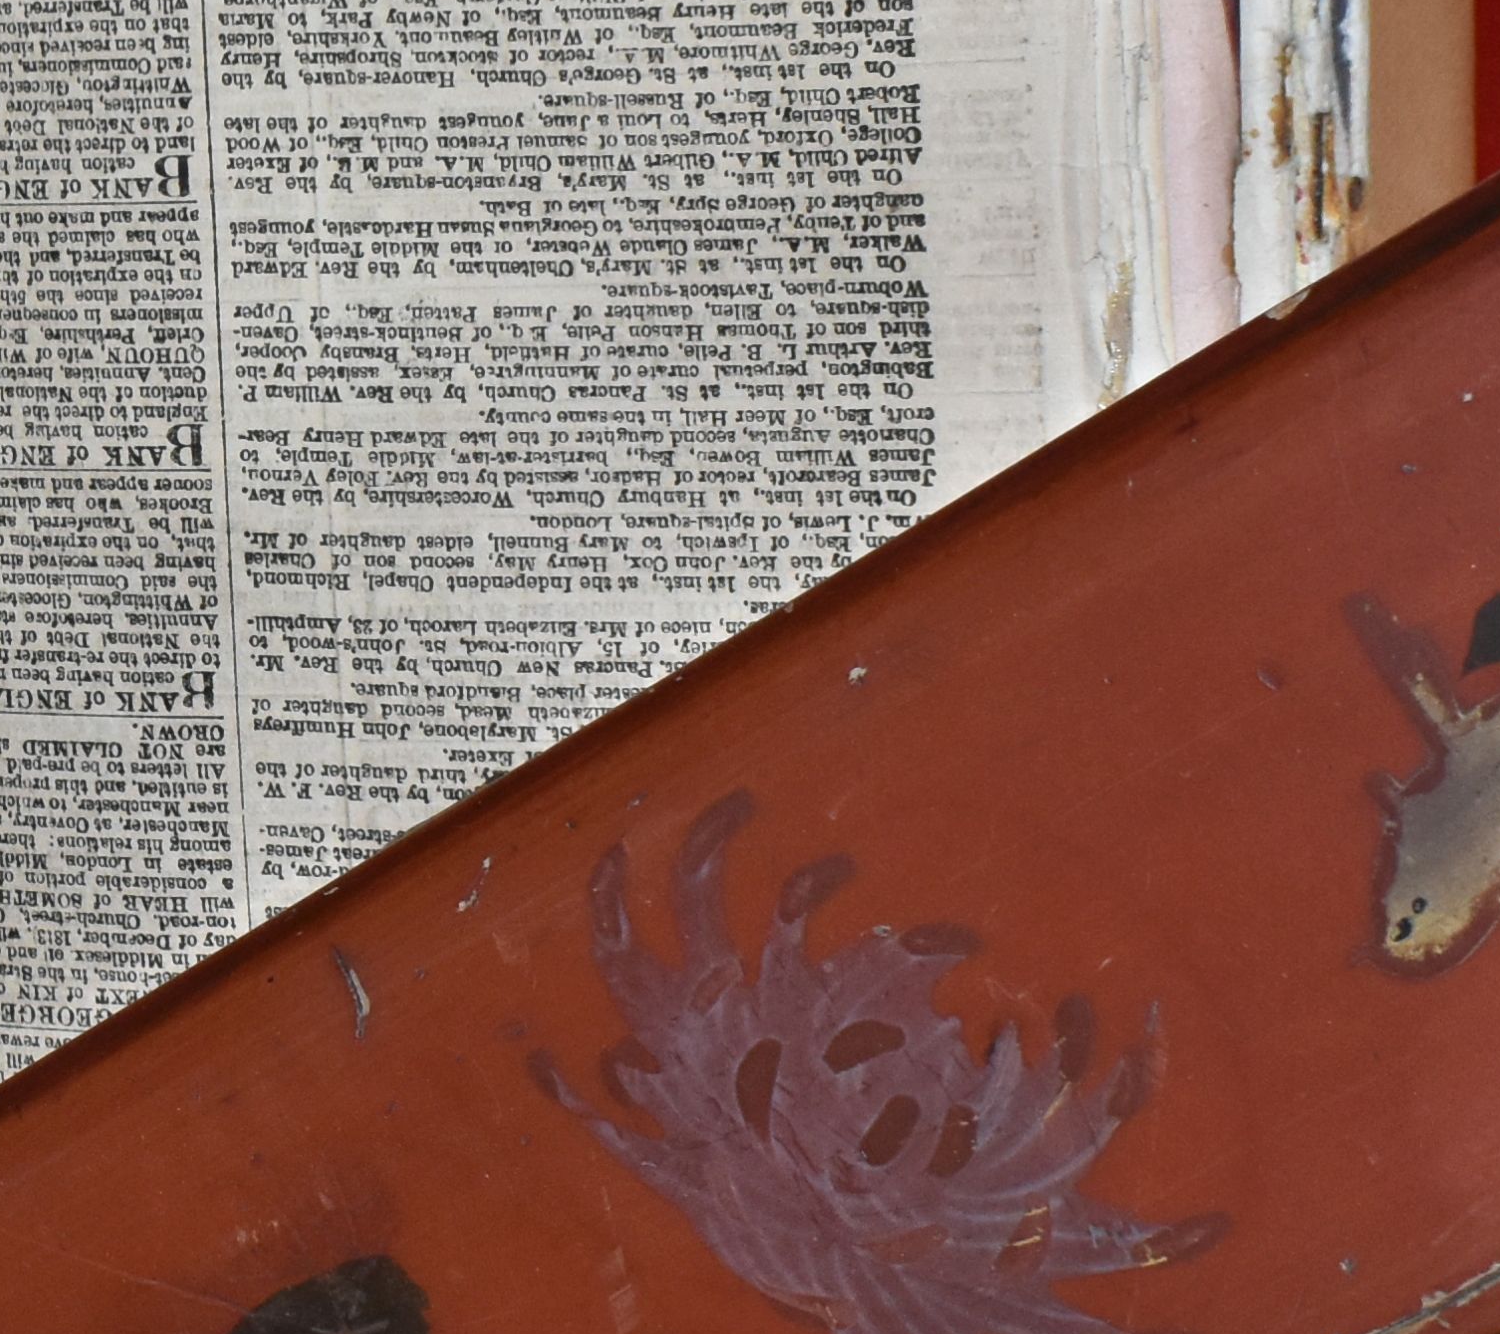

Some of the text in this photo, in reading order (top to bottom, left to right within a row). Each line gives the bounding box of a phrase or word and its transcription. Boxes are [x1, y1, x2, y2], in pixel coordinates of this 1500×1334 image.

[538, 90, 683, 111] Russell-square.
[695, 91, 715, 108] of
[780, 86, 841, 106] Child,
[846, 84, 920, 103] Robert
[2, 1001, 111, 1027] GEORGE
